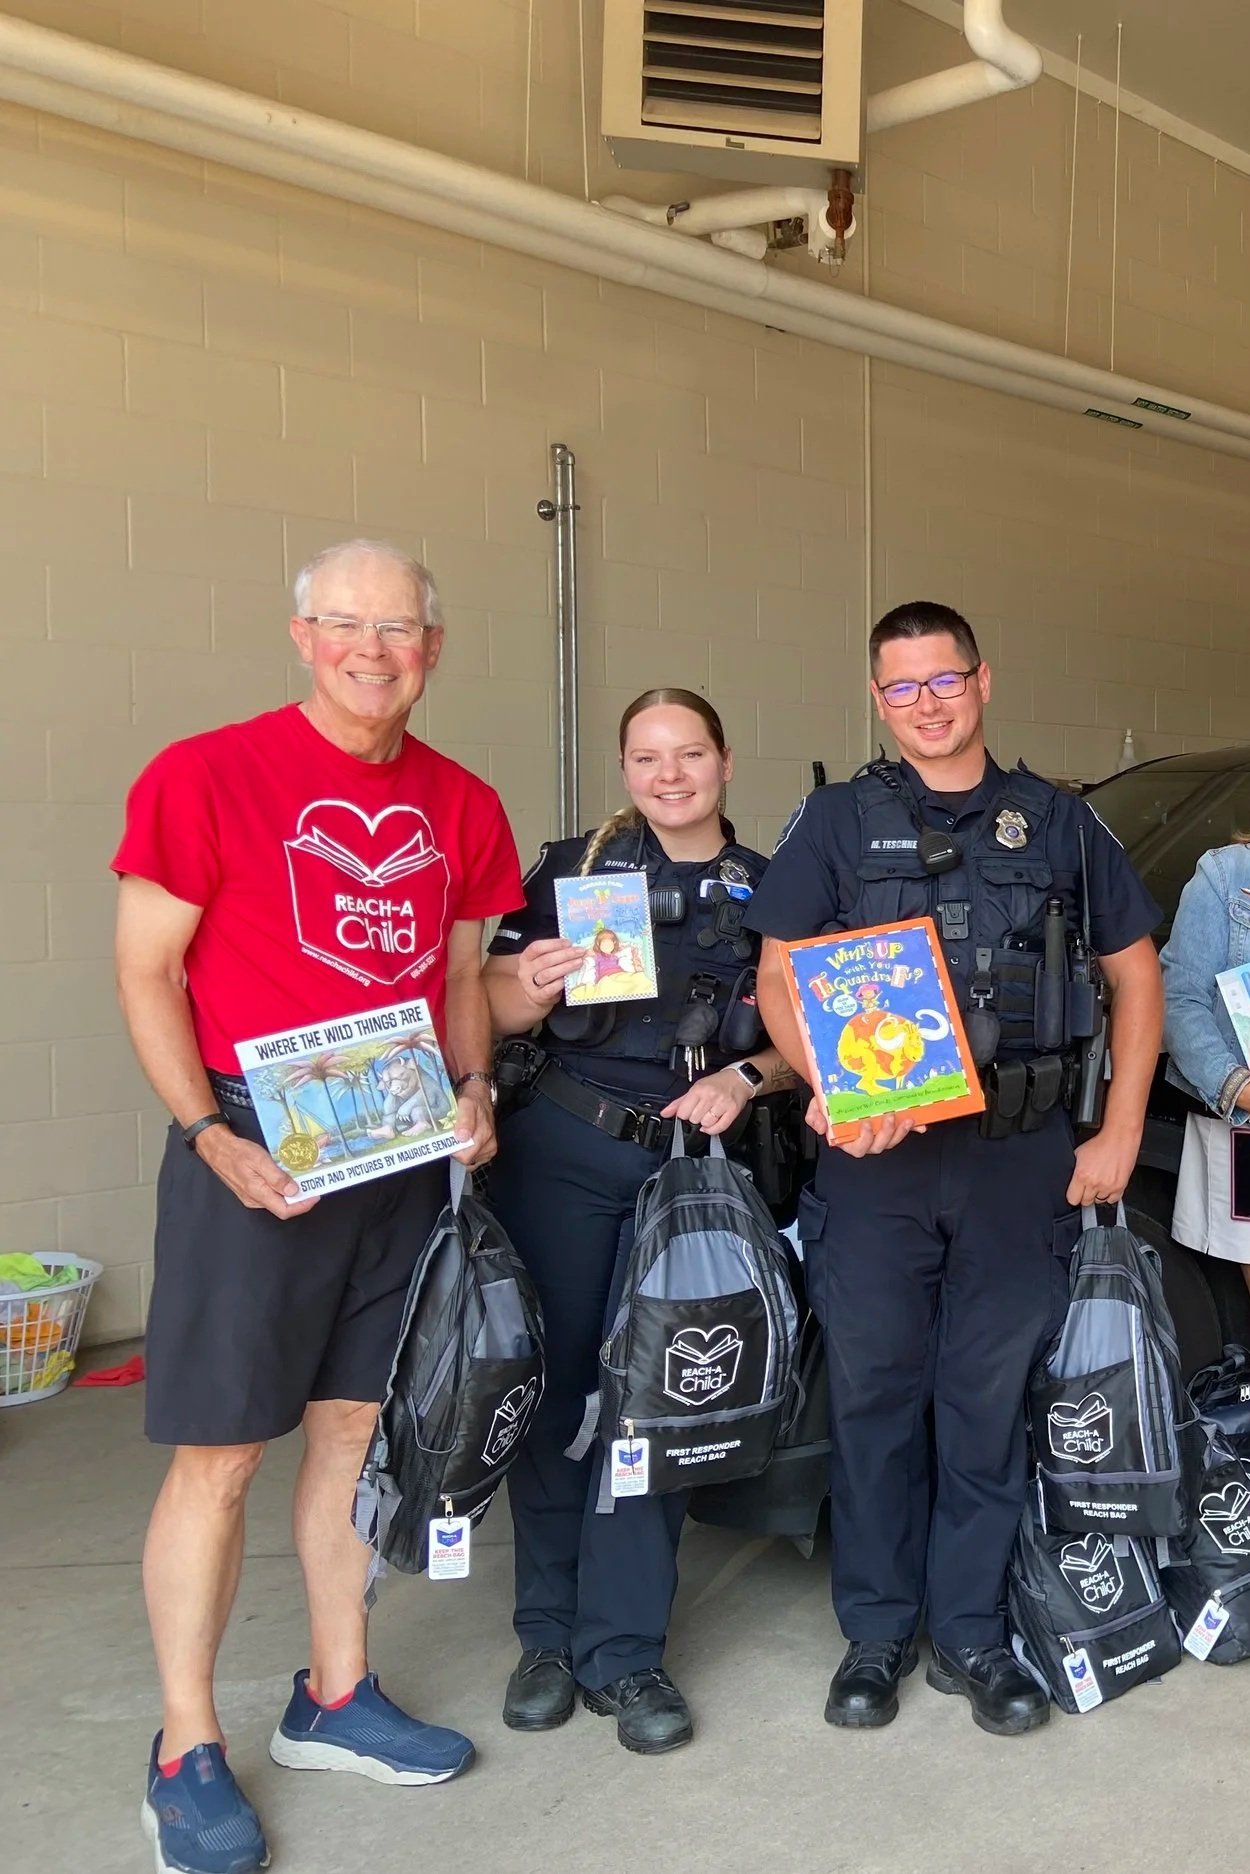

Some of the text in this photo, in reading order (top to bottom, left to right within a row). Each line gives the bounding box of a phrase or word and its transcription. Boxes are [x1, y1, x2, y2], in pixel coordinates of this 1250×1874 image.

[882, 840, 918, 849] TESCHNE
[605, 860, 648, 870] RUHLAD
[334, 894, 414, 918] REACH-A
[336, 915, 416, 954] Child
[876, 942, 904, 960] UP
[844, 964, 866, 974] with
[255, 1006, 424, 1061] WHERE THE WILD THINGS ARE
[300, 1176, 326, 1192] STORY
[328, 1170, 346, 1184] AND
[348, 1160, 384, 1178] PICTURES
[386, 1154, 397, 1166] BY
[398, 1144, 432, 1162] MAURICE
[682, 1366, 722, 1378] REACH-A
[680, 1374, 722, 1392] Child
[1063, 1430, 1099, 1440] REACH-A
[666, 1440, 742, 1457] FIRST RESPONDER
[1064, 1438, 1102, 1452] Child
[678, 1452, 726, 1466] REACH BAG
[1070, 1500, 1138, 1512] FIRST RESPONDER
[1084, 1510, 1109, 1518] REACH
[1080, 1570, 1110, 1588] REACH-A
[1084, 1576, 1116, 1602] Child
[1103, 1640, 1156, 1668] FIRST RESPONDER
[1116, 1654, 1150, 1676] REACH BAG
